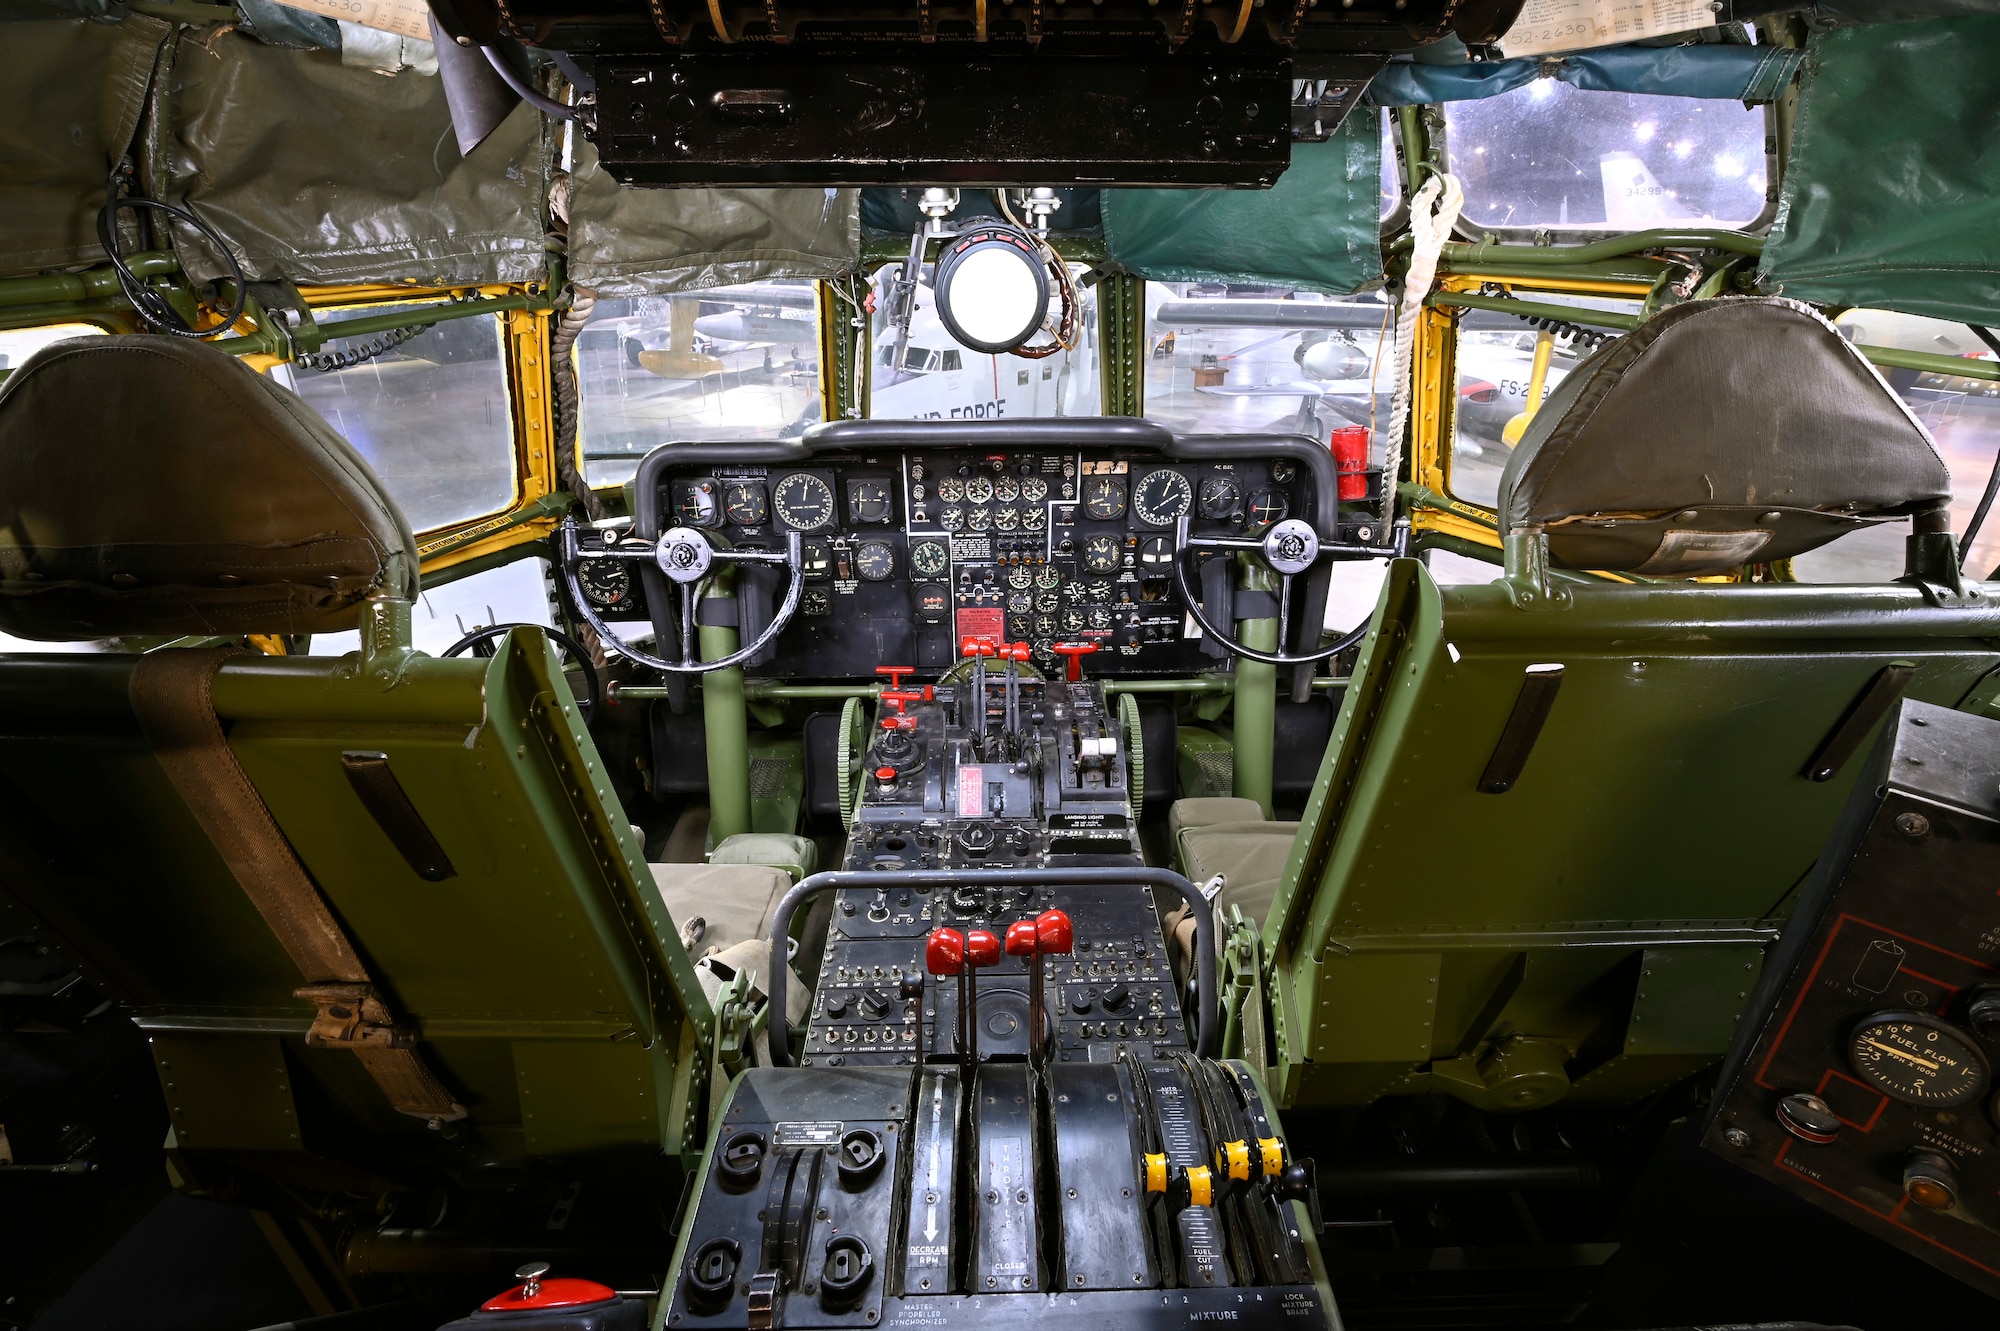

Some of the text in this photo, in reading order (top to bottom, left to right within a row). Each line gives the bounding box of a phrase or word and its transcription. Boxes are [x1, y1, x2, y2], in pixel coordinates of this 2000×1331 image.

[1887, 1024, 1898, 1033] 10
[1902, 1024, 1913, 1033] 12
[1871, 1052, 1881, 1061] 3
[1890, 1034, 1957, 1067] FUEL FLOW
[1887, 1052, 1905, 1064] PPH
[1916, 1066, 1937, 1078] 1000
[1913, 1079, 1925, 1088] 2
[1913, 1121, 1984, 1156] LOW PRESSURE
[1922, 1134, 1965, 1156] WARNING
[1783, 1158, 1822, 1180] GASOLINE
[1190, 1310, 1238, 1321] MIXTURE
